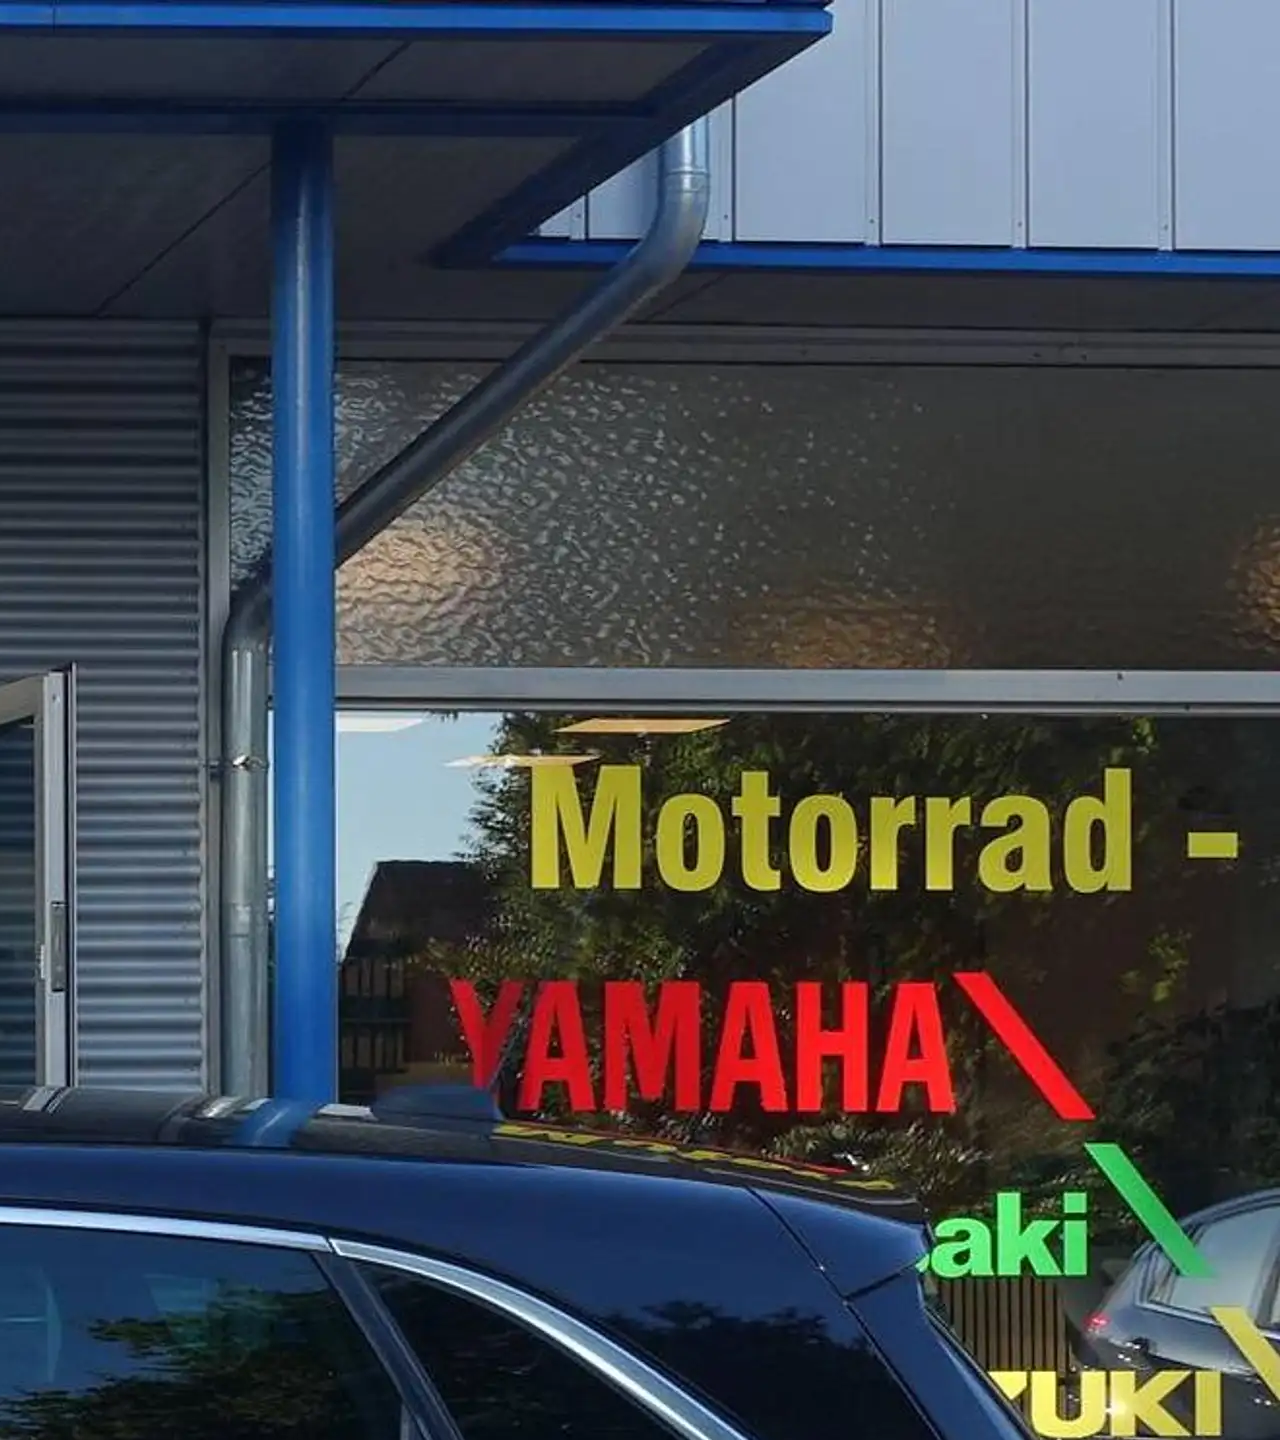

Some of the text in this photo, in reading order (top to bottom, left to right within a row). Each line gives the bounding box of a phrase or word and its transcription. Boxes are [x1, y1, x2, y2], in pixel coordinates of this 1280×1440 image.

[530, 764, 1132, 893] Motorrad
[448, 978, 957, 1113] YAMAHA
[915, 1192, 1088, 1279] aki
